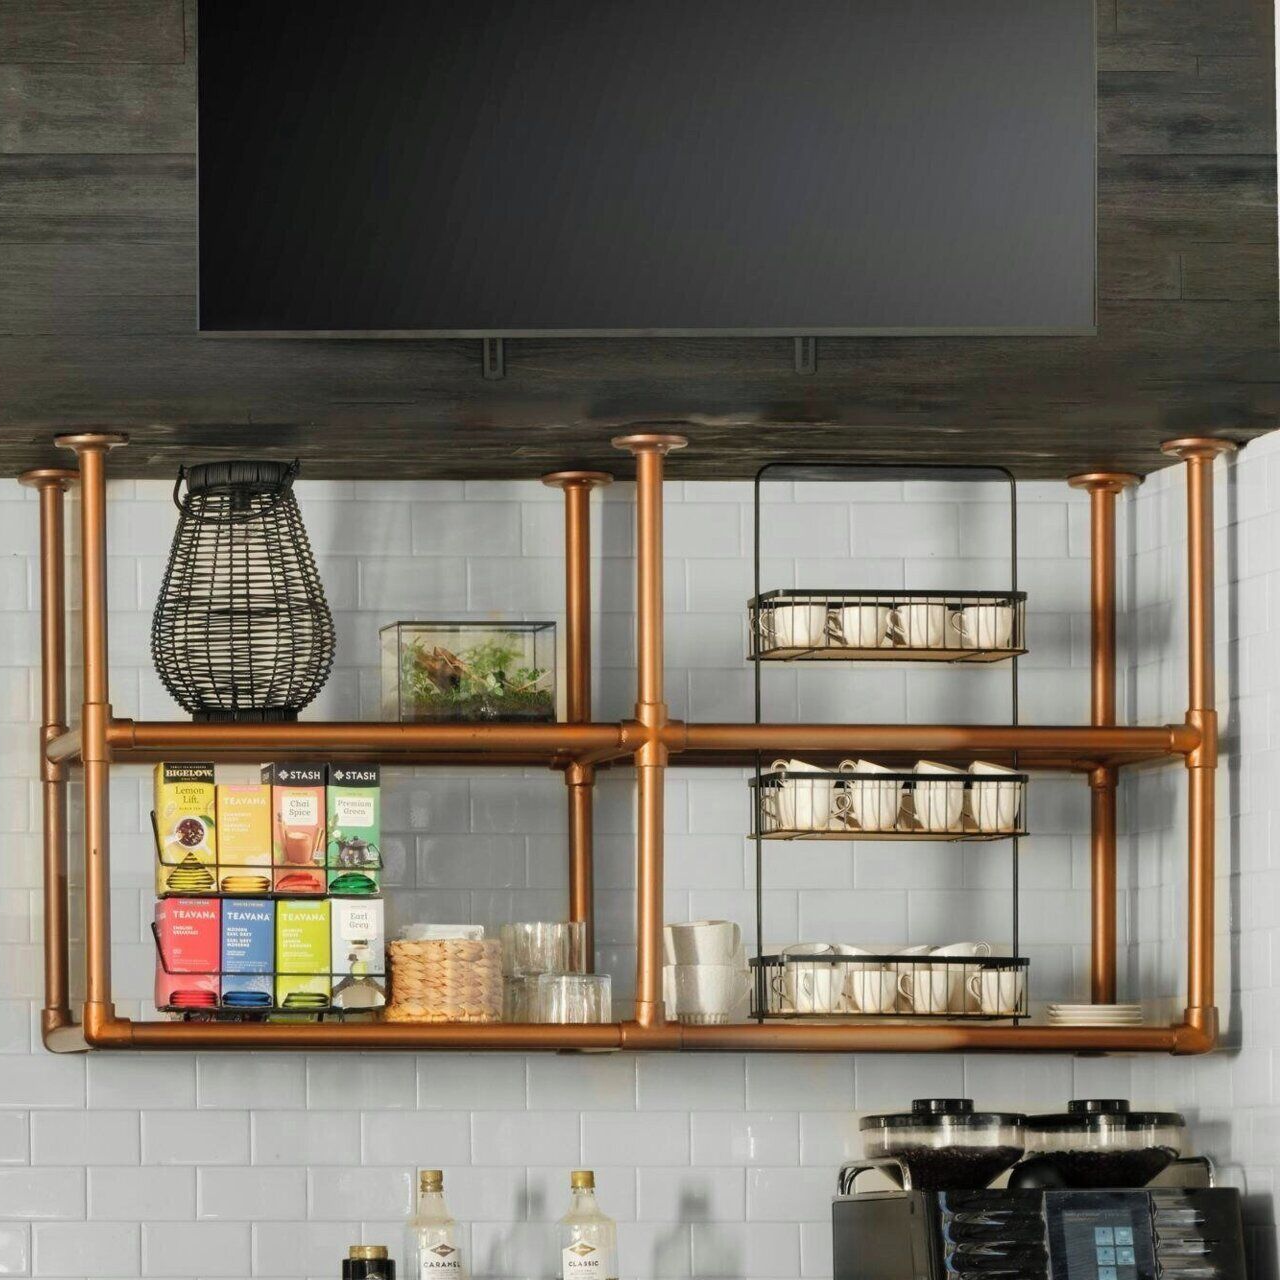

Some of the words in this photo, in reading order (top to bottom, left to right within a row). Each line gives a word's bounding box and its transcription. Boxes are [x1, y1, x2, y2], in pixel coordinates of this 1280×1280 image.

[290, 771, 321, 780] STASH
[345, 771, 376, 781] STASH
[175, 786, 204, 795] Lemon
[289, 808, 311, 817] Spice
[173, 910, 215, 919] TEAVANA
[227, 912, 270, 922] TEAVANA
[282, 913, 325, 922] TEAVANA
[350, 912, 368, 920] Earl
[349, 920, 369, 930] Grey
